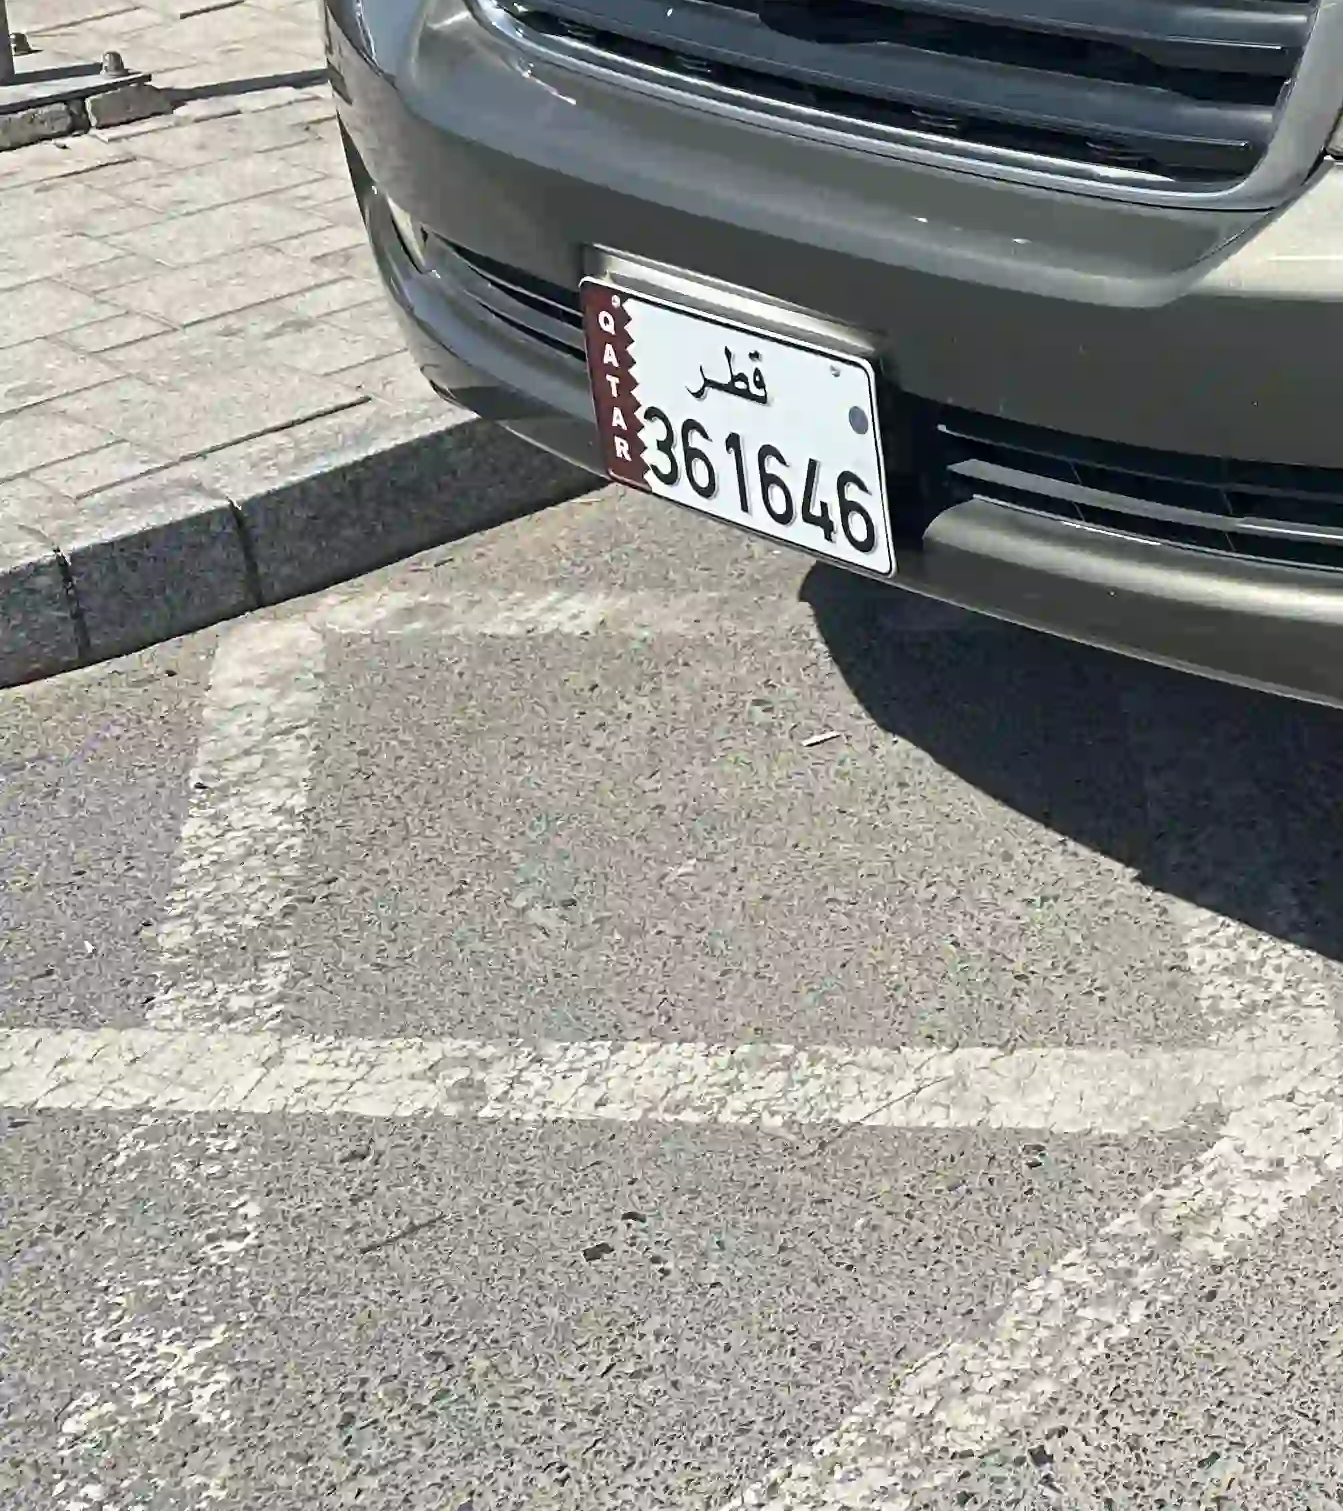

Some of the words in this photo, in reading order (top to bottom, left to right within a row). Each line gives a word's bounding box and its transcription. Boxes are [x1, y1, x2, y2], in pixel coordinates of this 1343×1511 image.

[598, 309, 632, 462] QATAR
[684, 345, 768, 405] قطر
[643, 406, 877, 554] 361646
